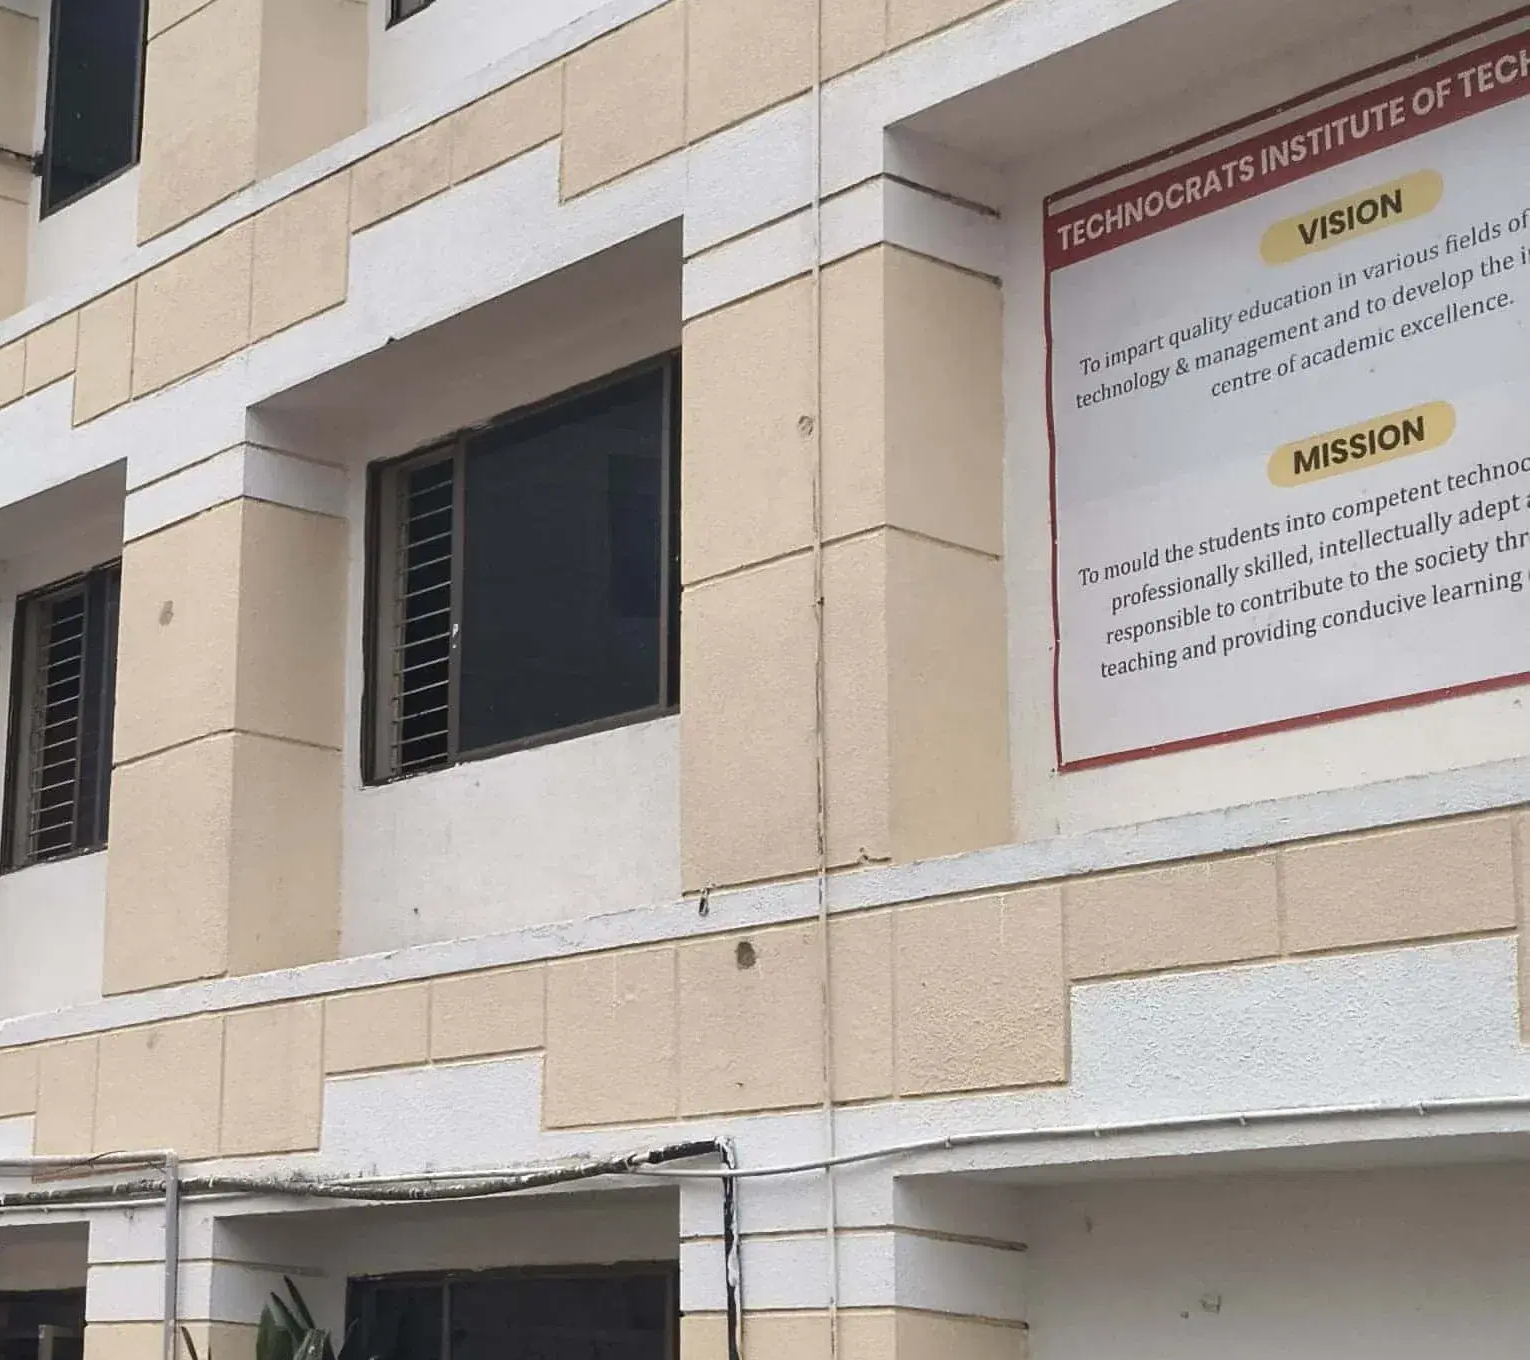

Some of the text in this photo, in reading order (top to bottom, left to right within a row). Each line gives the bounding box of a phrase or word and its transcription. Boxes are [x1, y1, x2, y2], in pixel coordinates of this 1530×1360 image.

[1057, 155, 1255, 251] TECHNOCRATS
[1261, 96, 1406, 175] INSTITUTE
[1412, 78, 1452, 116] OF
[1297, 188, 1403, 245] VISION
[1076, 366, 1170, 409] technology
[1175, 357, 1190, 376] &
[1195, 316, 1320, 369] management
[1323, 300, 1361, 329] and
[1366, 297, 1387, 315] to
[1392, 269, 1474, 306] develop
[1481, 255, 1514, 277] the
[1079, 356, 1101, 376] To
[1105, 335, 1165, 368] impart
[1169, 313, 1233, 349] quality
[1238, 280, 1332, 323] education
[1338, 271, 1357, 290] in
[1362, 244, 1439, 280] various
[1445, 221, 1502, 254] fields
[1211, 292, 1514, 397] centre of academic excellence.
[1293, 416, 1426, 474] MISSION
[1078, 567, 1099, 586] To
[1104, 548, 1160, 581] mould
[1165, 543, 1194, 563] the
[1198, 520, 1281, 556] students
[1286, 511, 1326, 533] into
[1332, 478, 1442, 522] competent
[1111, 493, 1521, 615] professionally skilled, intellectually adept
[1101, 571, 1523, 678] teaching and providing conducive learning
[1106, 605, 1211, 644] responsible
[1217, 601, 1235, 618] to
[1240, 576, 1343, 613] contribute
[1349, 570, 1369, 588] to
[1376, 560, 1408, 581] the
[1414, 541, 1489, 572] society
